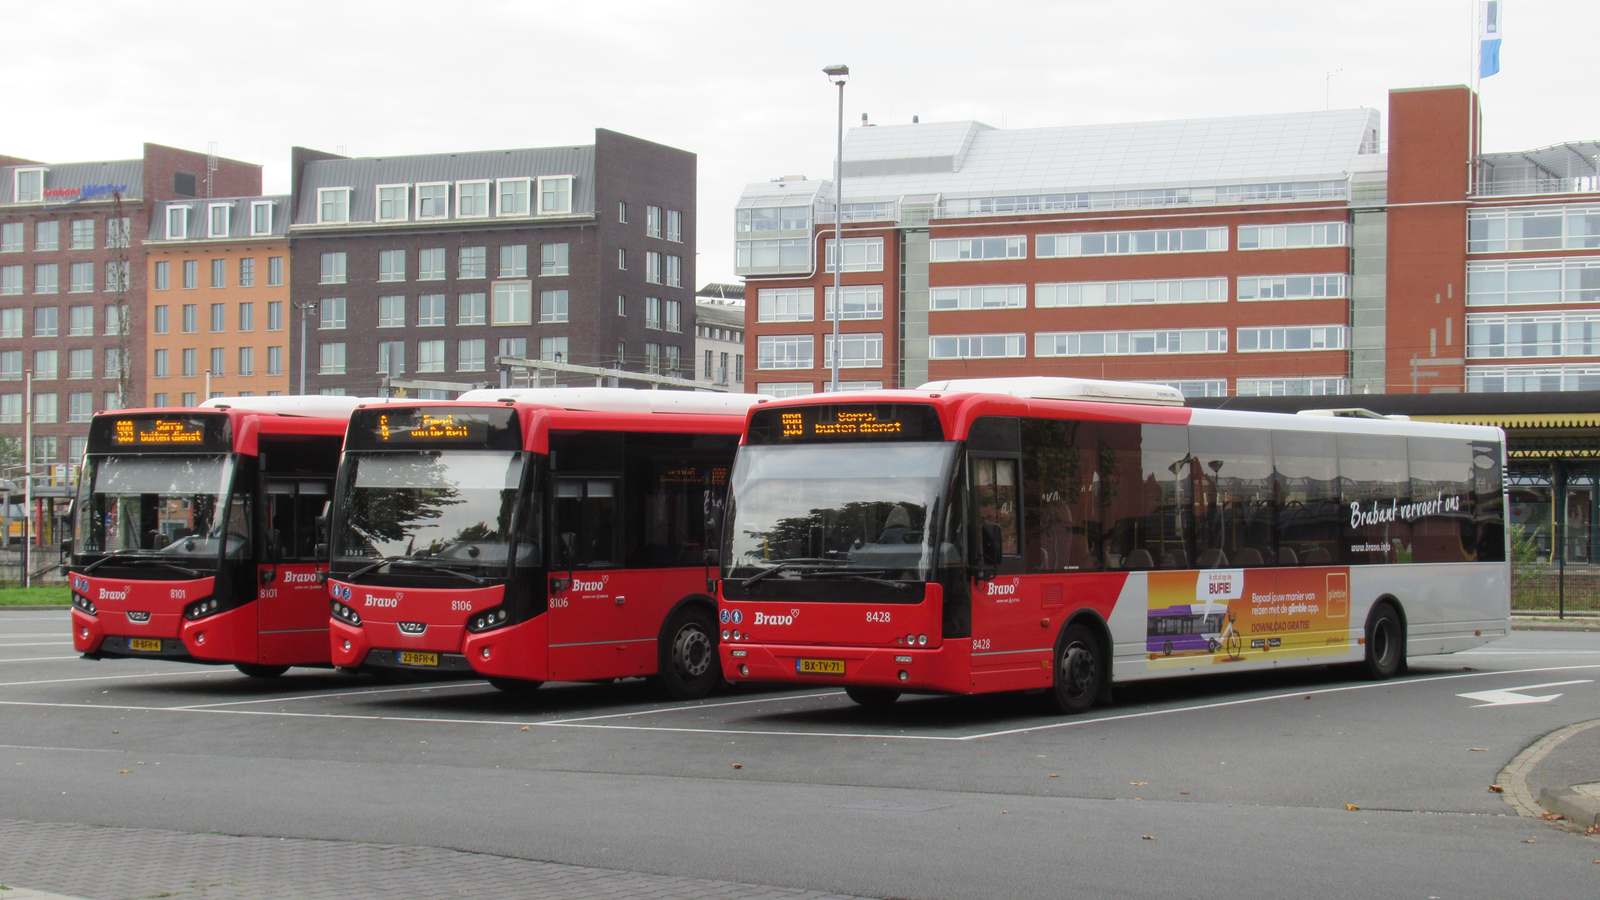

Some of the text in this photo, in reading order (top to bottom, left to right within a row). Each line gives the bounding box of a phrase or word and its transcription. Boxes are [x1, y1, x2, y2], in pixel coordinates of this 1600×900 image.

[815, 422, 901, 434] buiten dienst
[140, 430, 201, 442] buiten dienst
[1350, 491, 1460, 529] Brabant vervoert ons
[284, 571, 317, 583] Bravo
[572, 579, 604, 592] Bravo
[987, 582, 1016, 596] Bravo
[99, 588, 127, 600] Bravo
[170, 588, 186, 599] 8101
[260, 588, 278, 599] 8101
[364, 594, 398, 608] Bravo
[451, 600, 472, 612] 8106
[549, 597, 569, 609] 8106
[129, 611, 148, 620] VDL
[754, 612, 792, 625] Bravo
[866, 612, 891, 623] 8428
[401, 623, 423, 631] VDL
[972, 639, 991, 650] 8428
[804, 660, 840, 672] BX-TV-71
